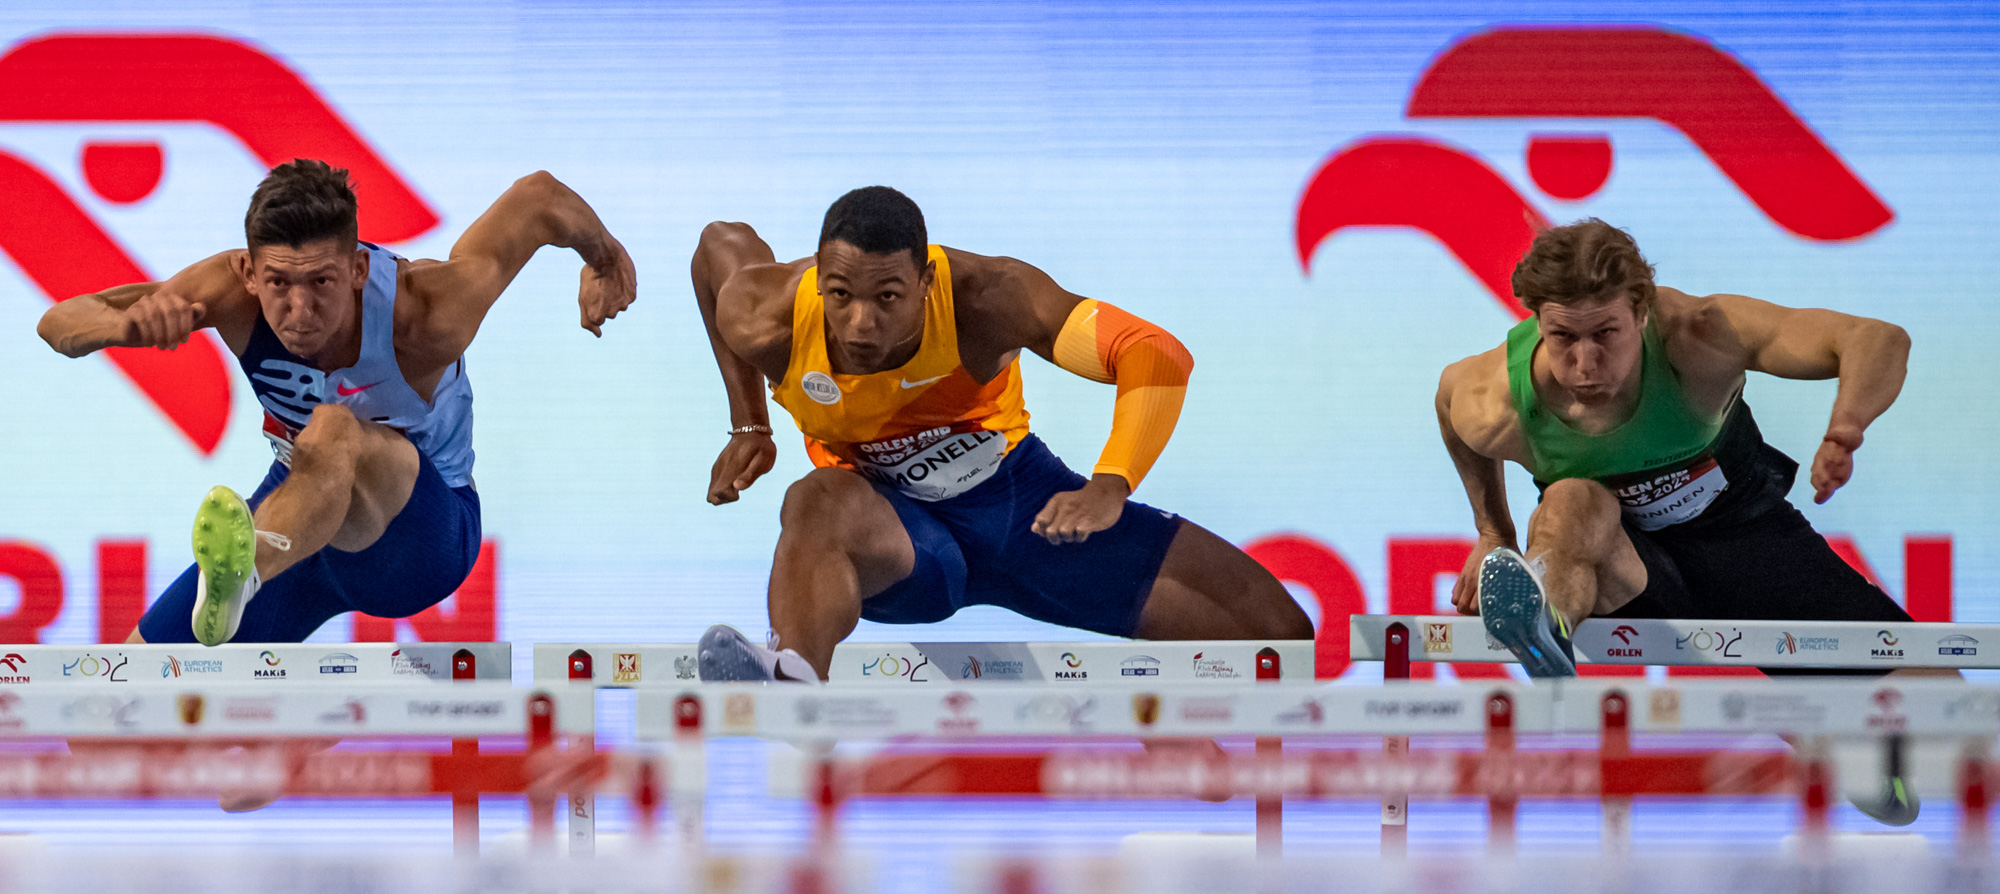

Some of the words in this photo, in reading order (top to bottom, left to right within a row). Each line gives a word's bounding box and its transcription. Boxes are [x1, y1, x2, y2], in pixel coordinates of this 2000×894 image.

[860, 435, 916, 453] ORLEN
[917, 426, 951, 440] CUP
[1617, 481, 1653, 497] LEN
[1607, 648, 1643, 657] ORLEN
